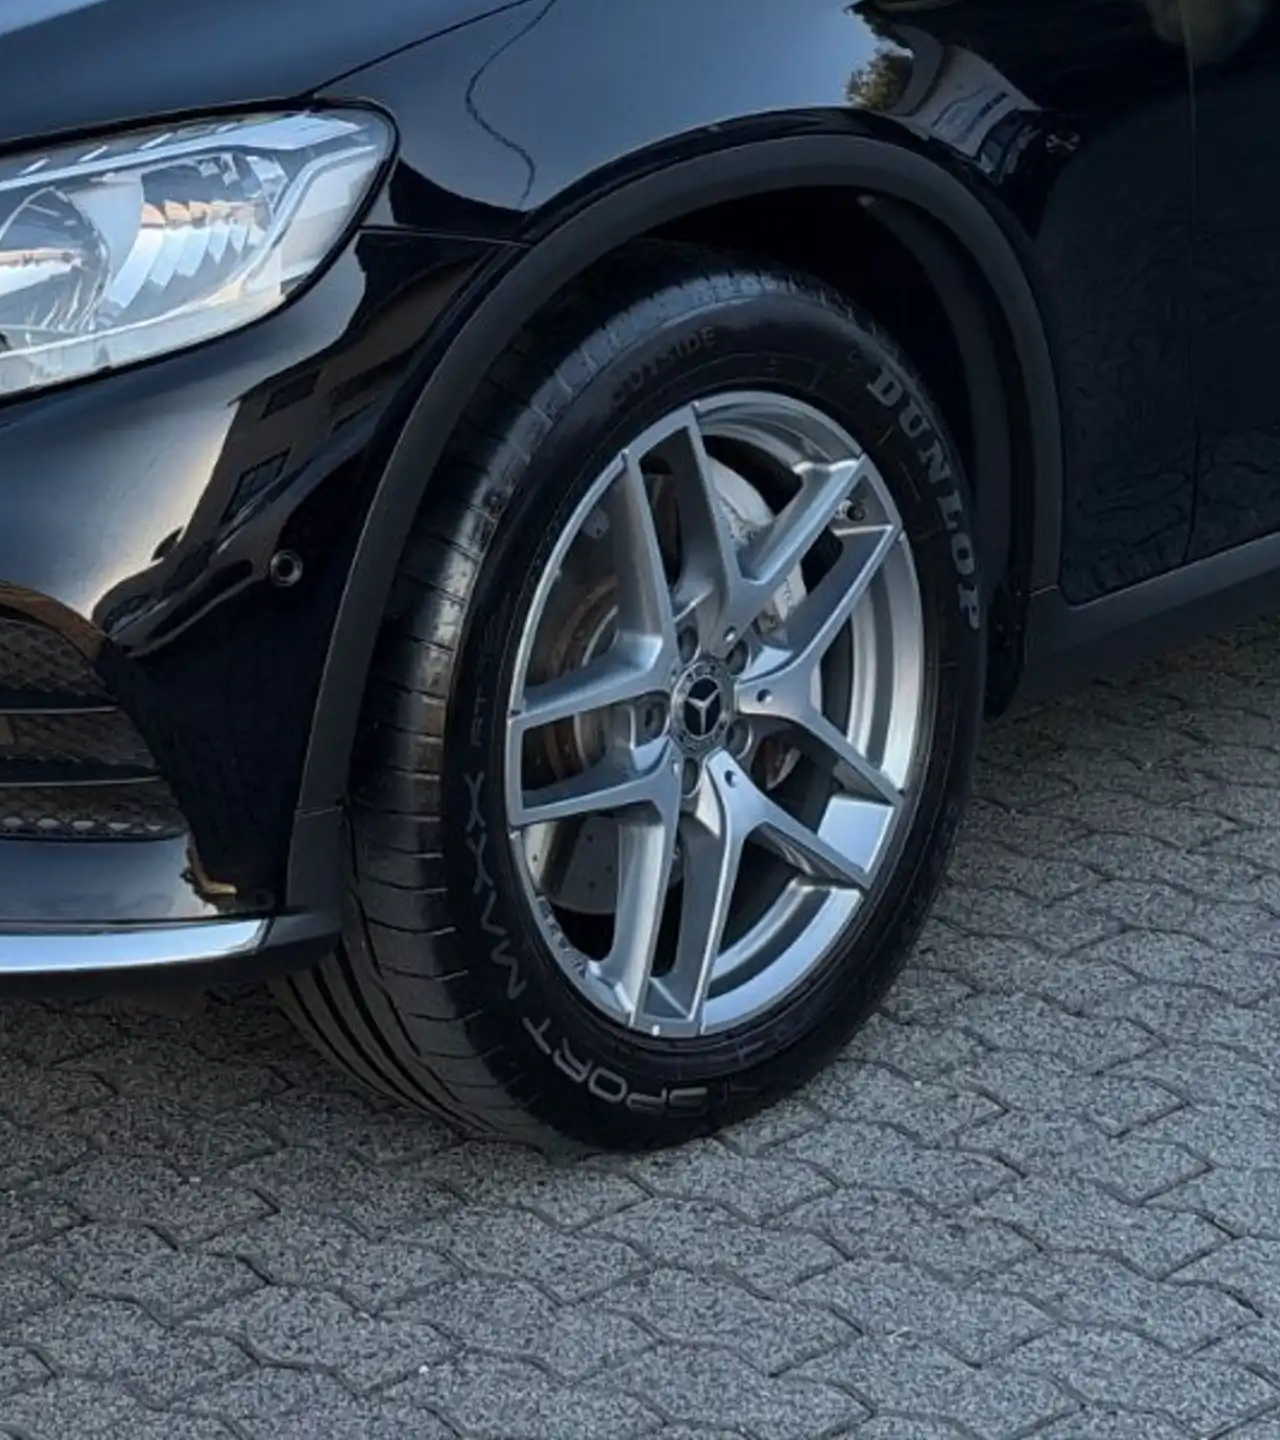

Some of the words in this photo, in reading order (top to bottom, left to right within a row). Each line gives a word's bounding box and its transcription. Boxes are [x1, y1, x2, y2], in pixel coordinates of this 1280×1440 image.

[867, 365, 979, 629] DUNLOP
[465, 772, 526, 1000] MAXX
[523, 1016, 708, 1118] SPORT
